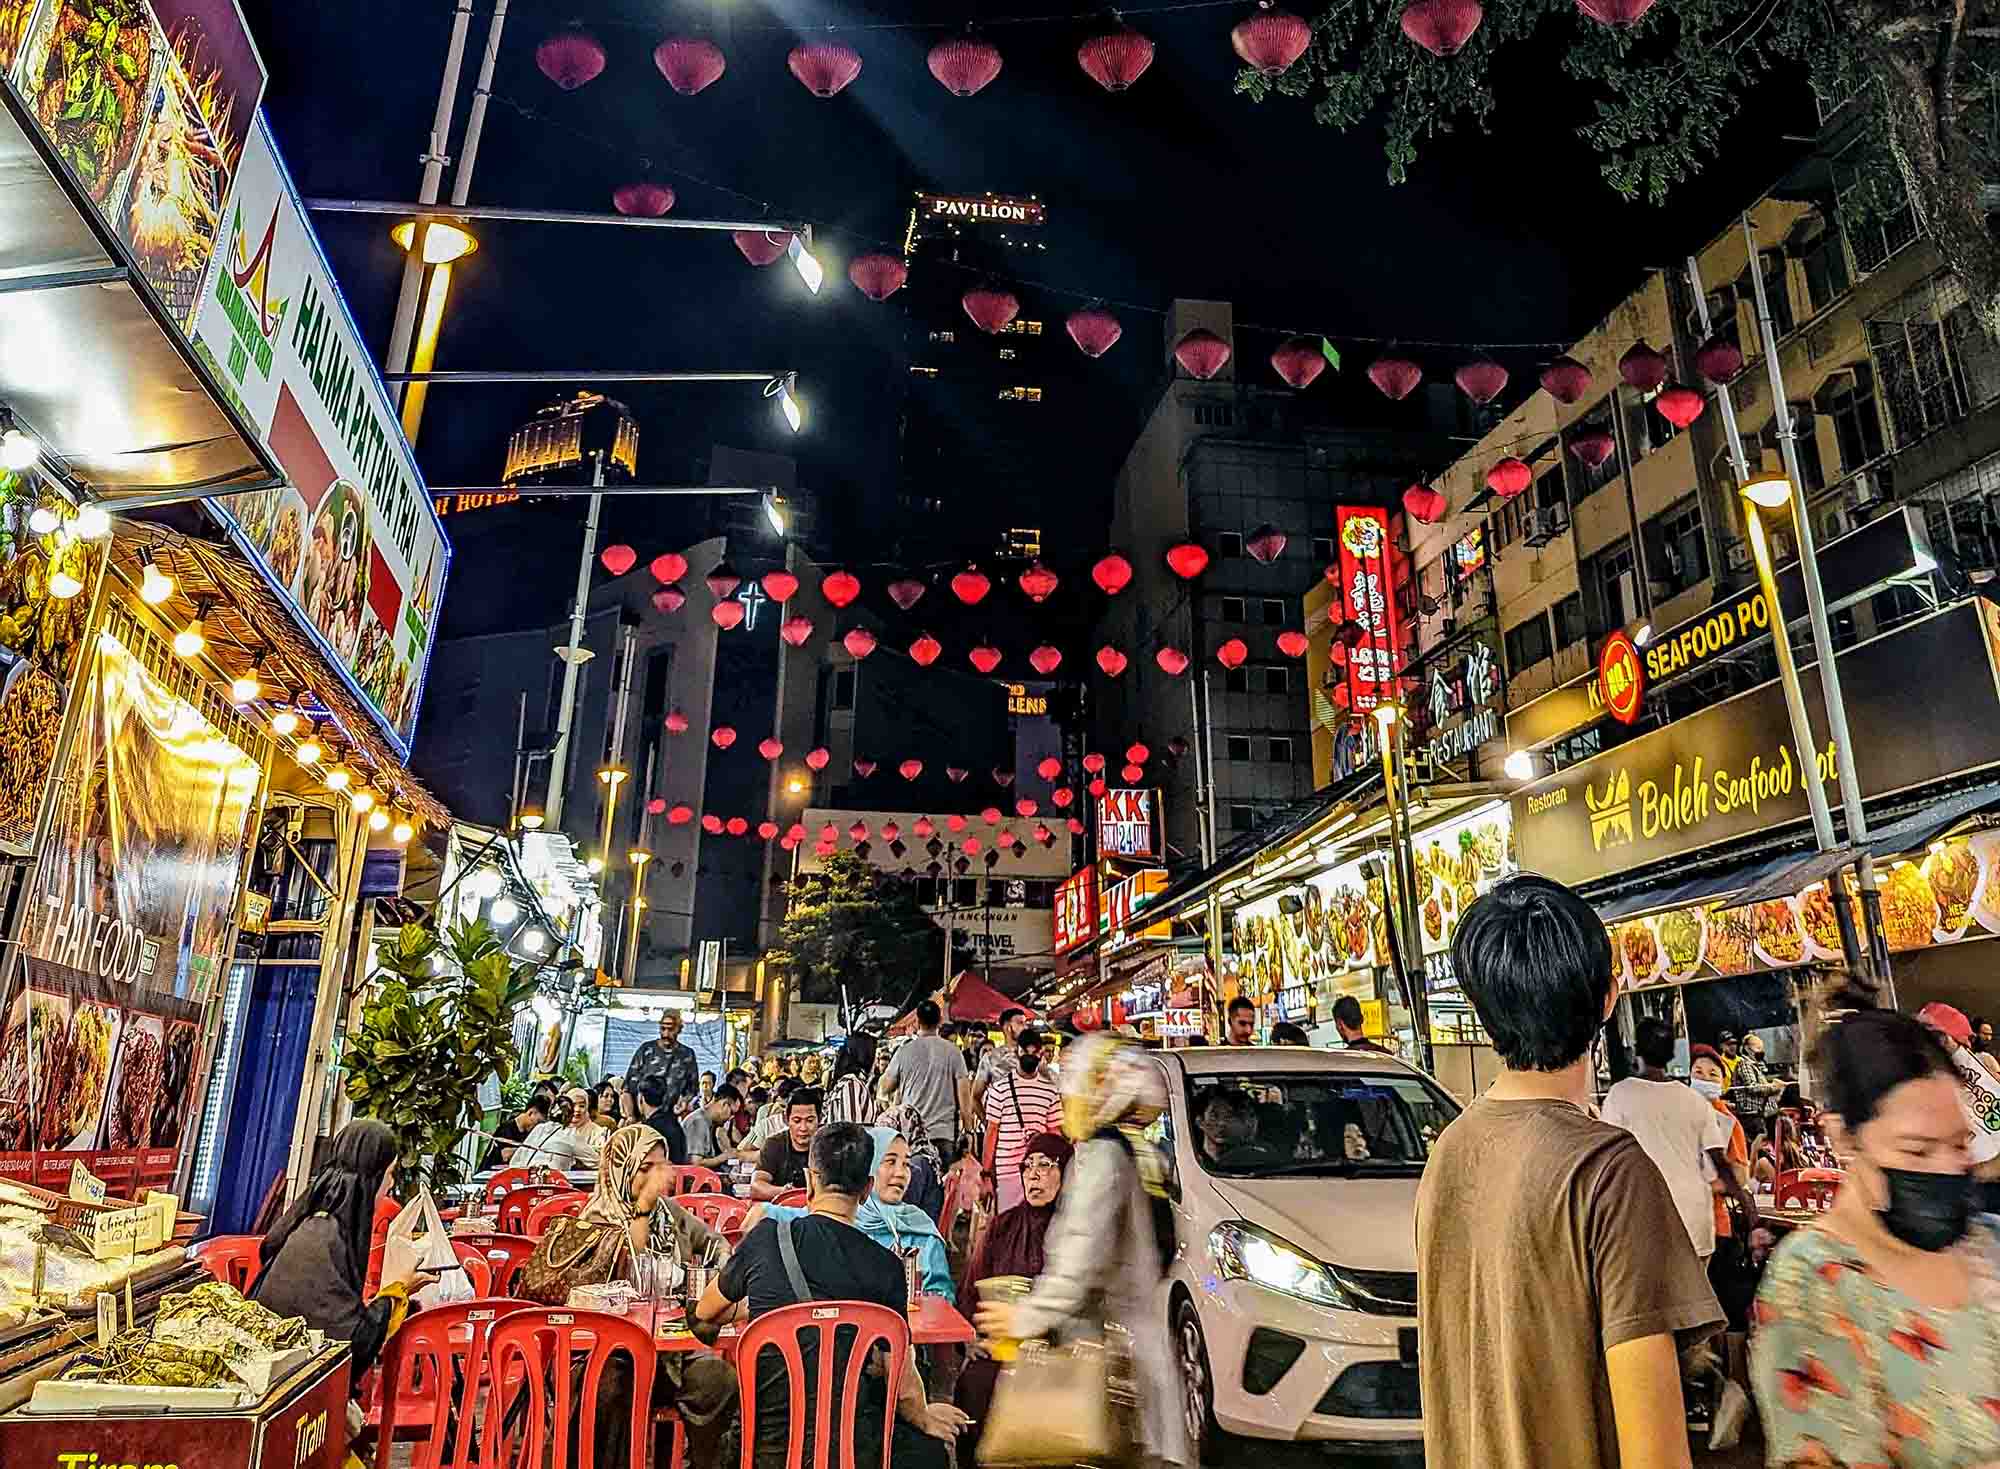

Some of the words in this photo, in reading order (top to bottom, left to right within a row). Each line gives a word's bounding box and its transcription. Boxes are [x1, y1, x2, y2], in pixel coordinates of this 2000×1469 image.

[933, 200, 1025, 220] PAVILION
[291, 273, 356, 452] HALIMA
[351, 385, 401, 528] PATTAYA
[391, 477, 420, 568] THAI
[1647, 612, 1735, 680] SEAFOOD
[1737, 594, 1769, 637] PO
[1429, 707, 1498, 765] RESTAURANT
[1104, 789, 1145, 821] KK
[1528, 787, 1568, 815] Restoran
[1638, 756, 1709, 838] Boleh
[1714, 745, 1793, 816] Seafood
[1801, 741, 1839, 789] ot
[1119, 824, 1133, 852] 24
[39, 893, 94, 969] THAI
[87, 914, 144, 983] FOOD
[1165, 1010, 1191, 1025] KK
[294, 1410, 328, 1469] Tiram
